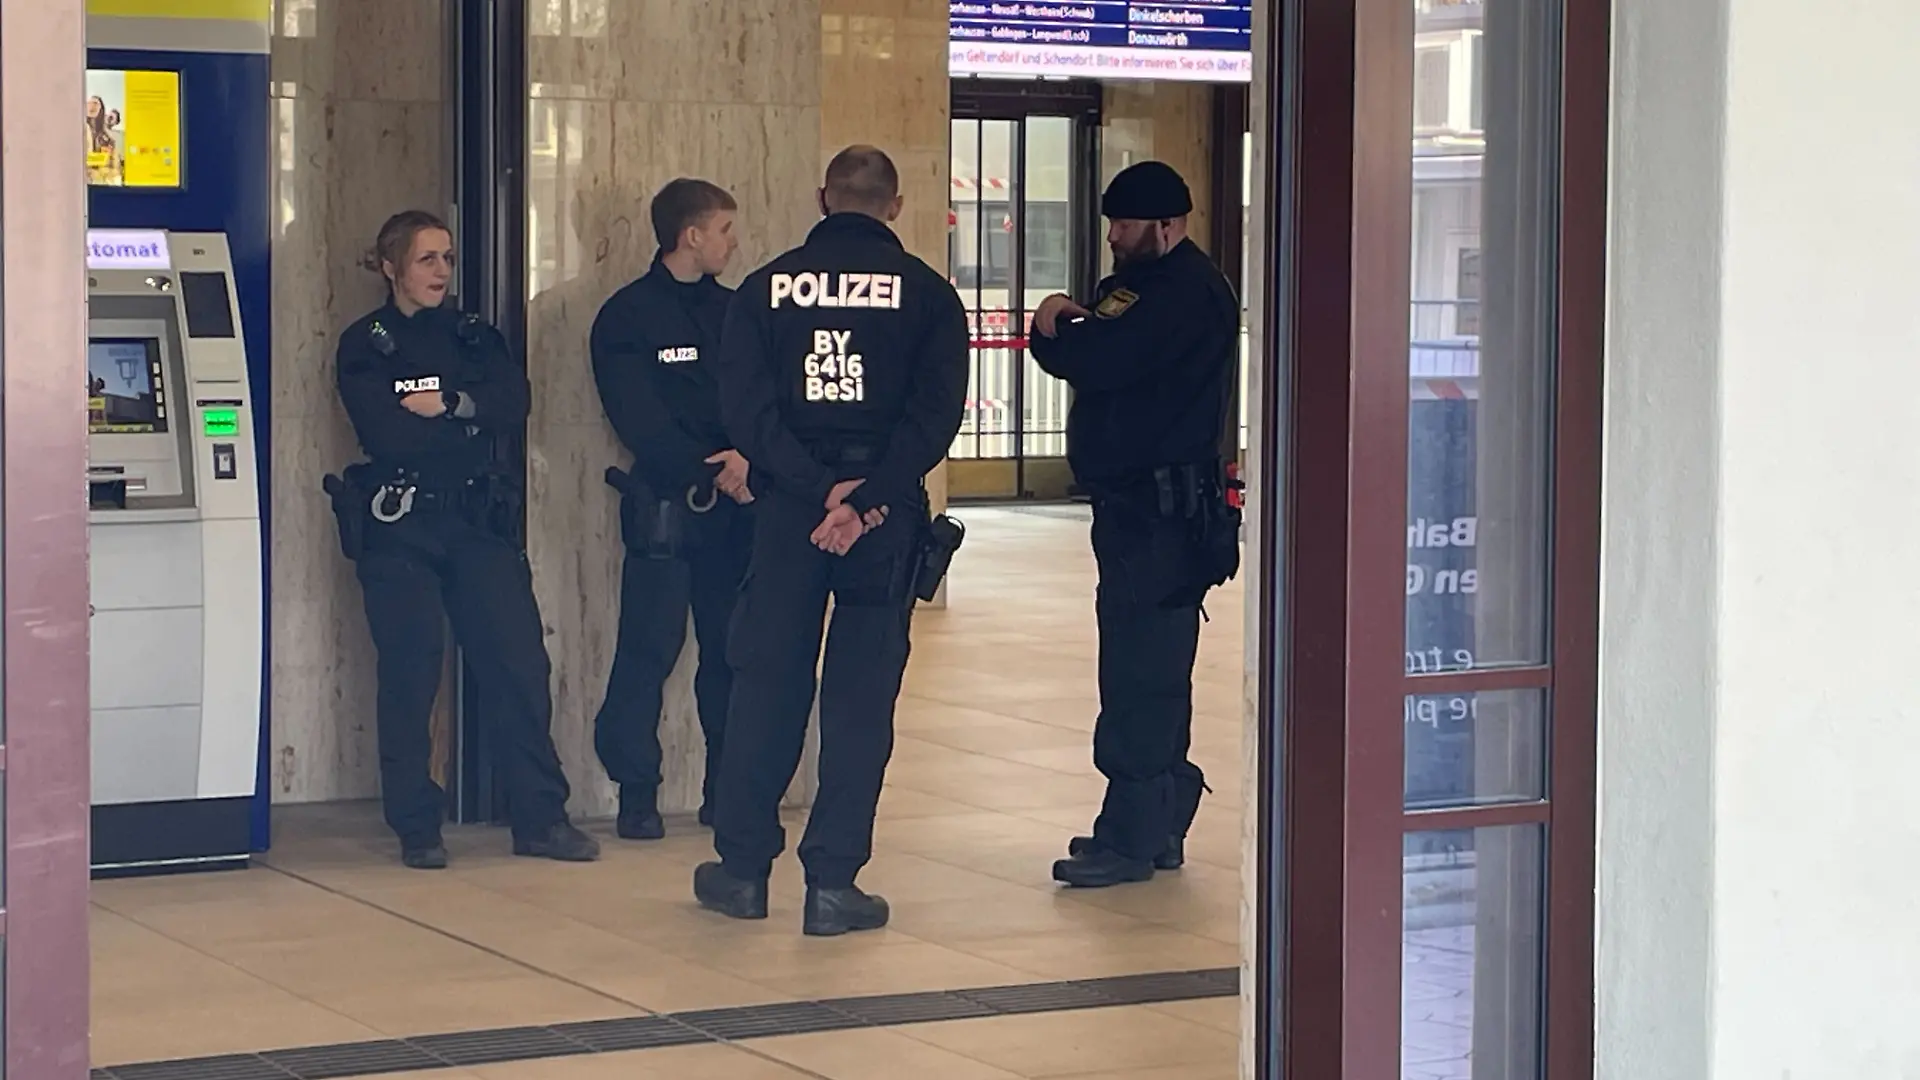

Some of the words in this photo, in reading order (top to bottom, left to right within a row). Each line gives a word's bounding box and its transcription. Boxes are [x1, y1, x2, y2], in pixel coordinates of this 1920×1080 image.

[1128, 7, 1204, 24] Dinkelscherben
[1128, 30, 1188, 46] Donauwörth
[966, 49, 1020, 63] Geltendorf
[1022, 53, 1041, 65] und
[1097, 53, 1120, 67] Bitte
[1121, 55, 1177, 69] informieren
[1179, 56, 1194, 70] Sie
[1196, 57, 1214, 70] sich
[1217, 57, 1238, 71] über
[87, 240, 160, 258] tomat
[770, 272, 902, 309] POLIZEI
[814, 330, 851, 355] BY
[804, 353, 864, 378] 6416
[805, 377, 864, 402] BeSi
